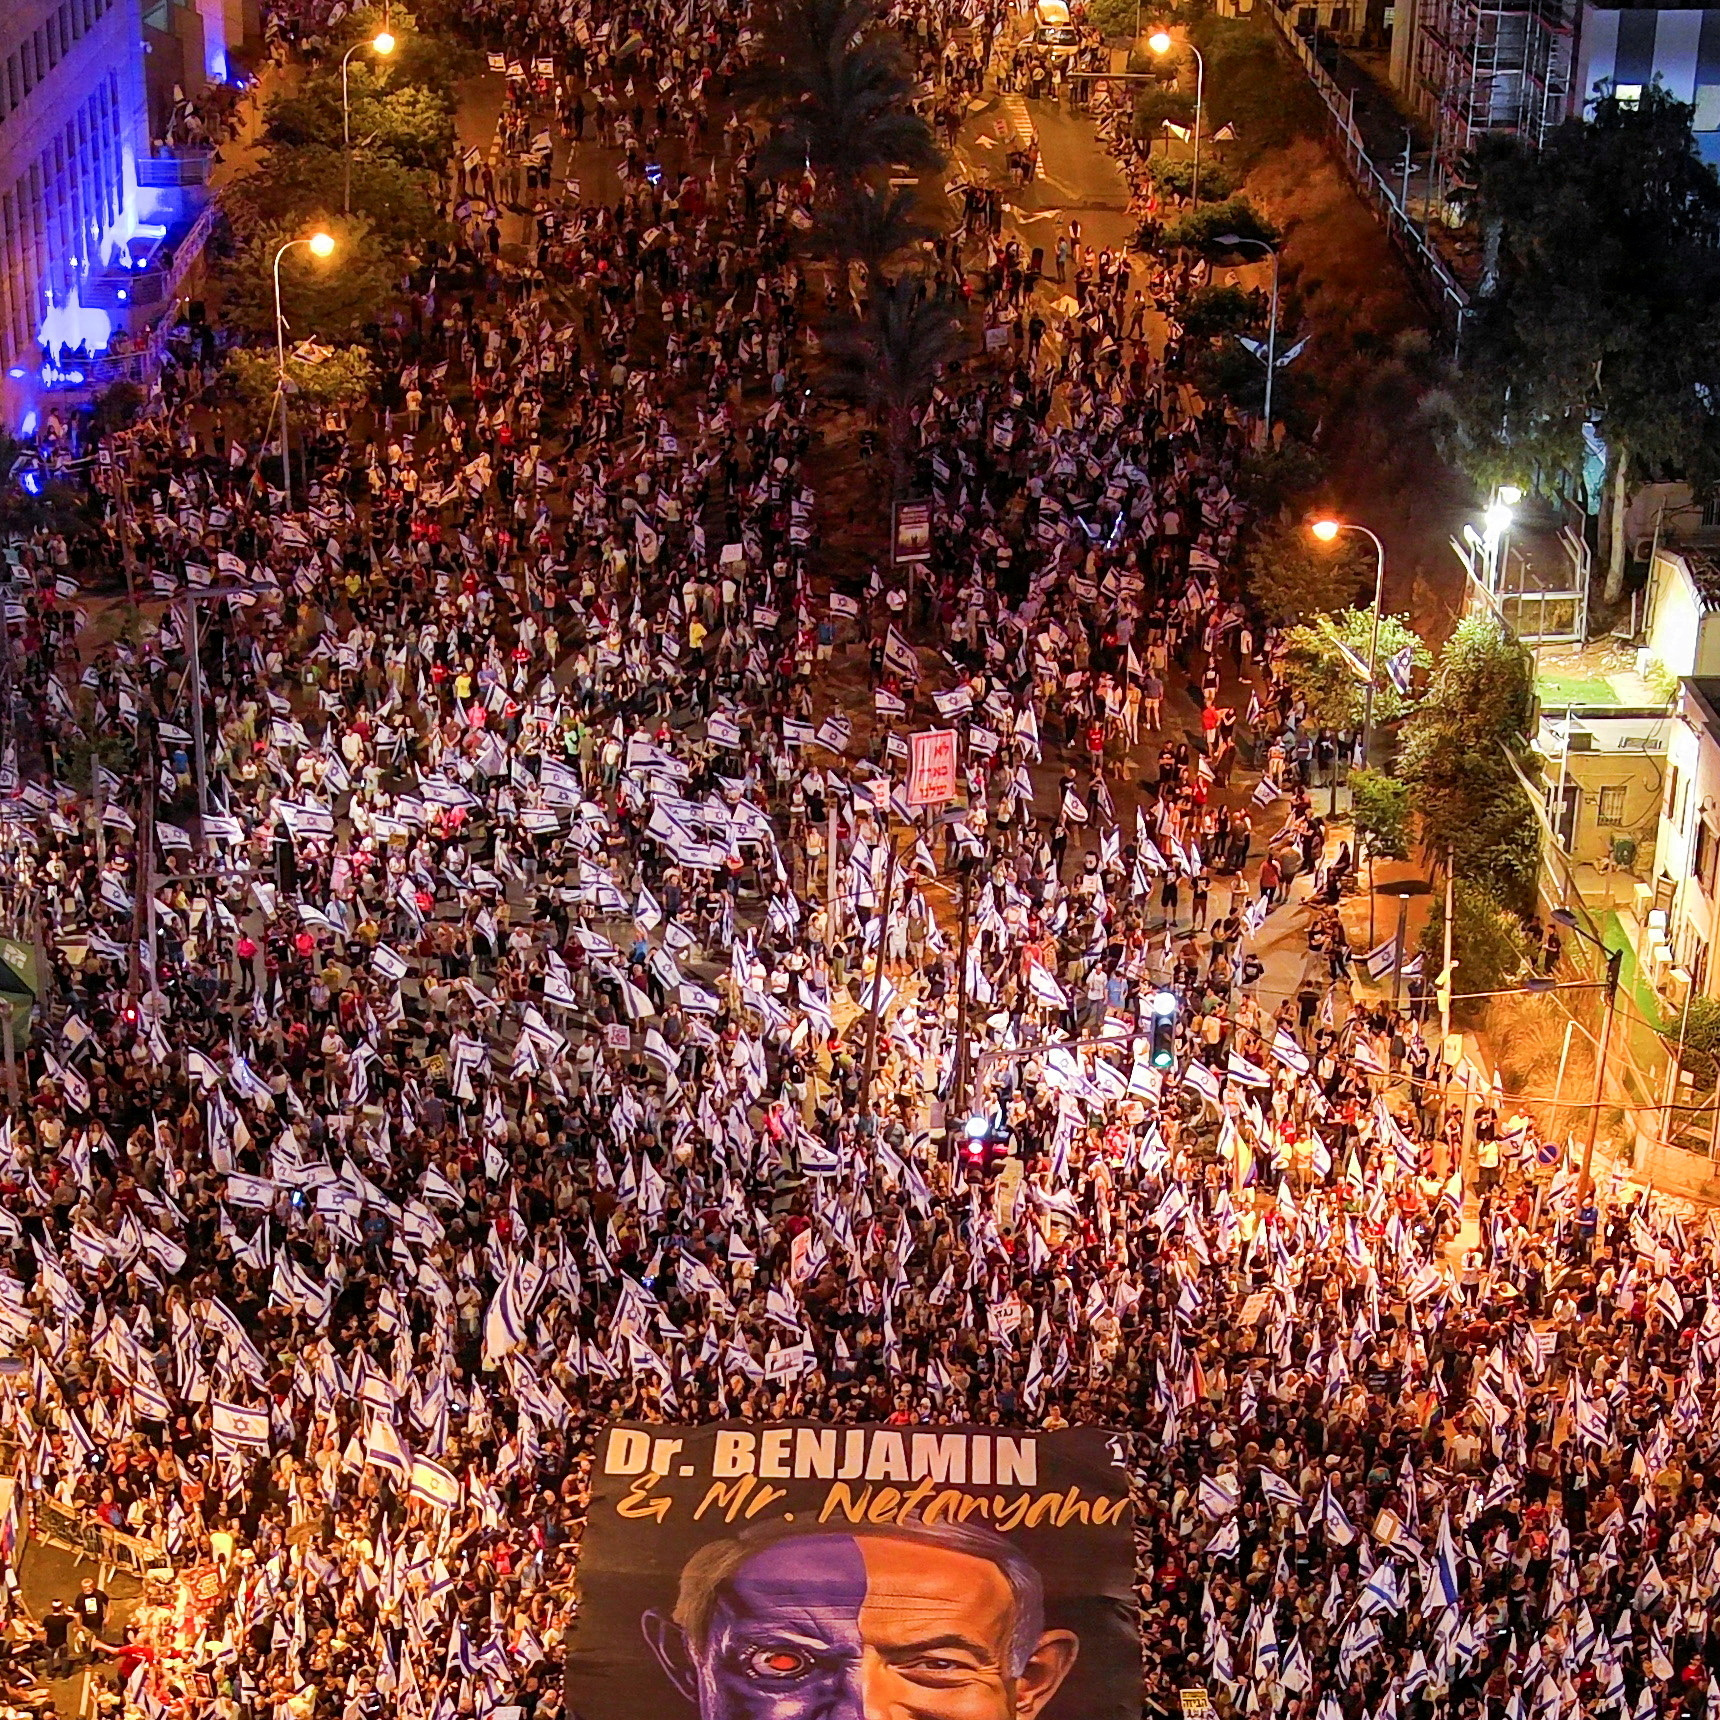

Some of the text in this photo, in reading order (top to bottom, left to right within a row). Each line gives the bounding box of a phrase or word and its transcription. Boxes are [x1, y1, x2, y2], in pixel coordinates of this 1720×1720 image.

[605, 1428, 1037, 1487] Dr. BENJAMIN
[692, 1478, 795, 1523] Mr.
[818, 1477, 1131, 1534] Netanyahu
